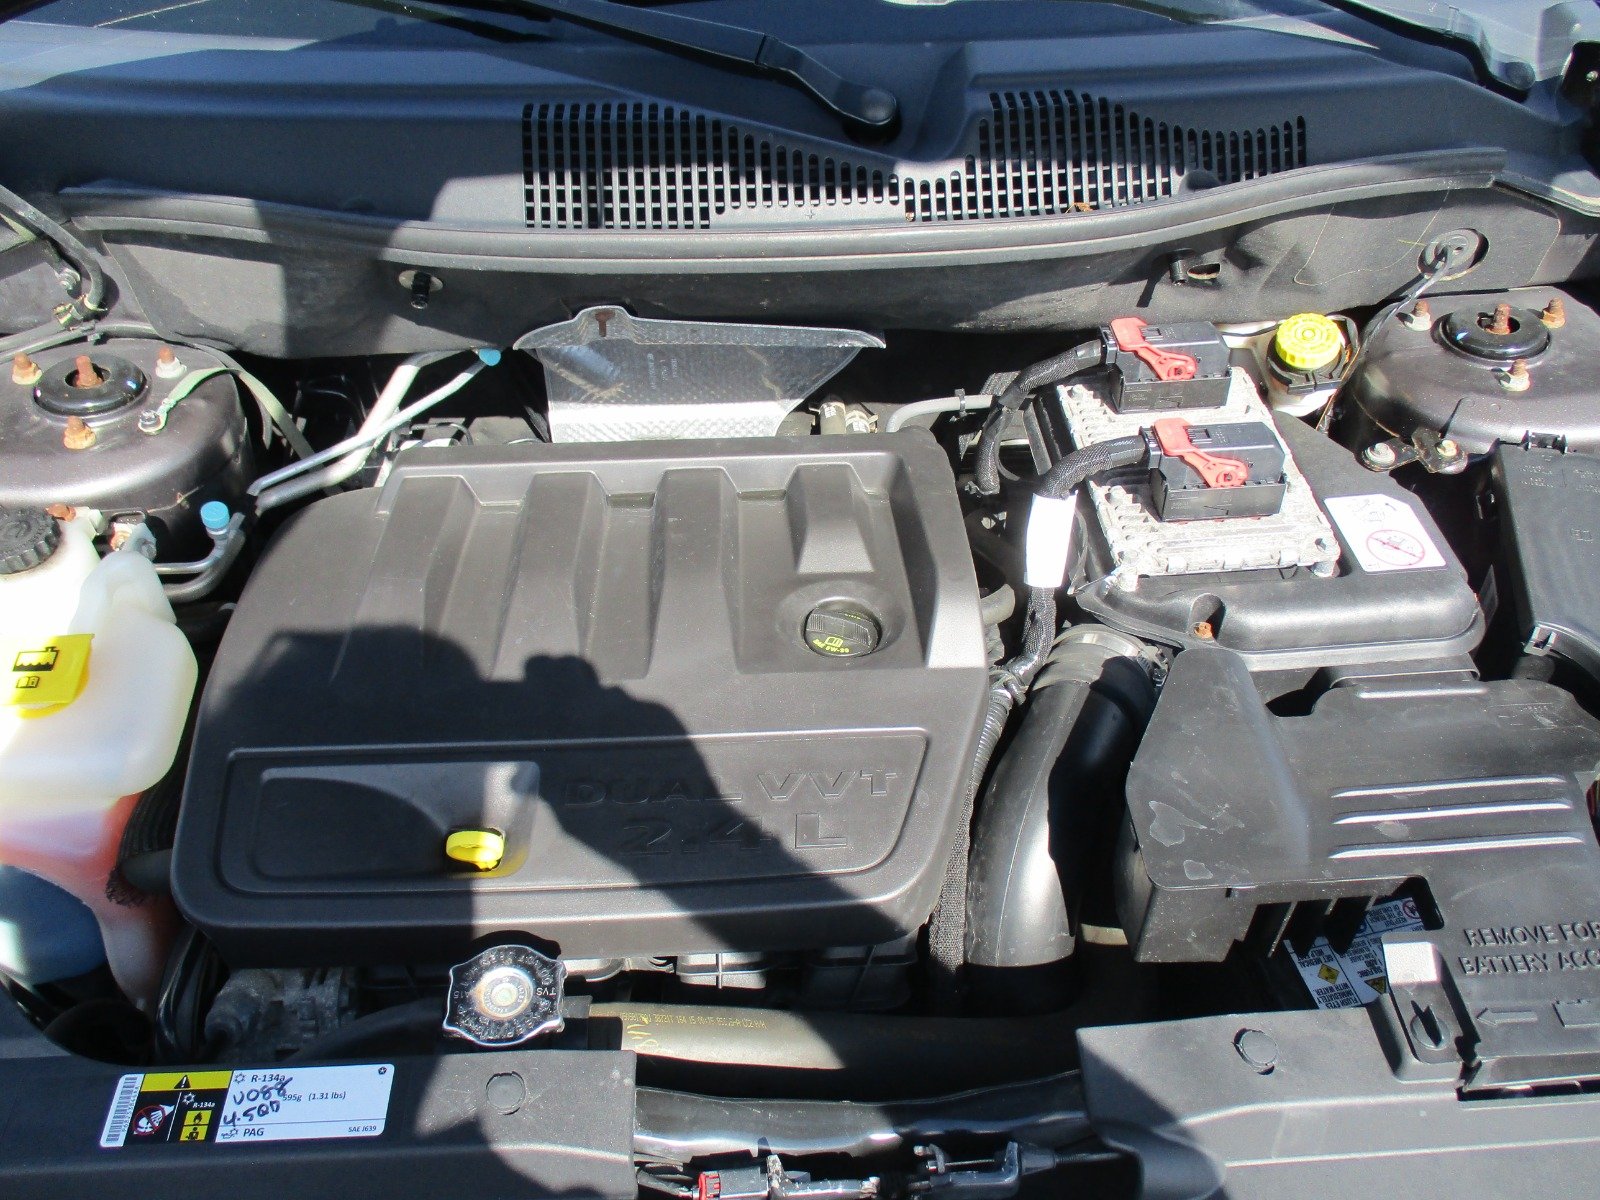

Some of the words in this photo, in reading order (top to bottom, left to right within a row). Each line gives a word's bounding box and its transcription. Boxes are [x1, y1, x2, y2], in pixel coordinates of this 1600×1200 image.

[757, 769, 897, 800] VVT
[794, 813, 847, 849] L
[1463, 924, 1558, 947] REMOVE
[1458, 952, 1549, 975] BATTERY
[536, 987, 556, 996] TVS
[251, 1073, 286, 1083] R-134a
[308, 1092, 329, 1101] (1.31
[331, 1091, 347, 1100] lbs)
[243, 1127, 265, 1137] PAG
